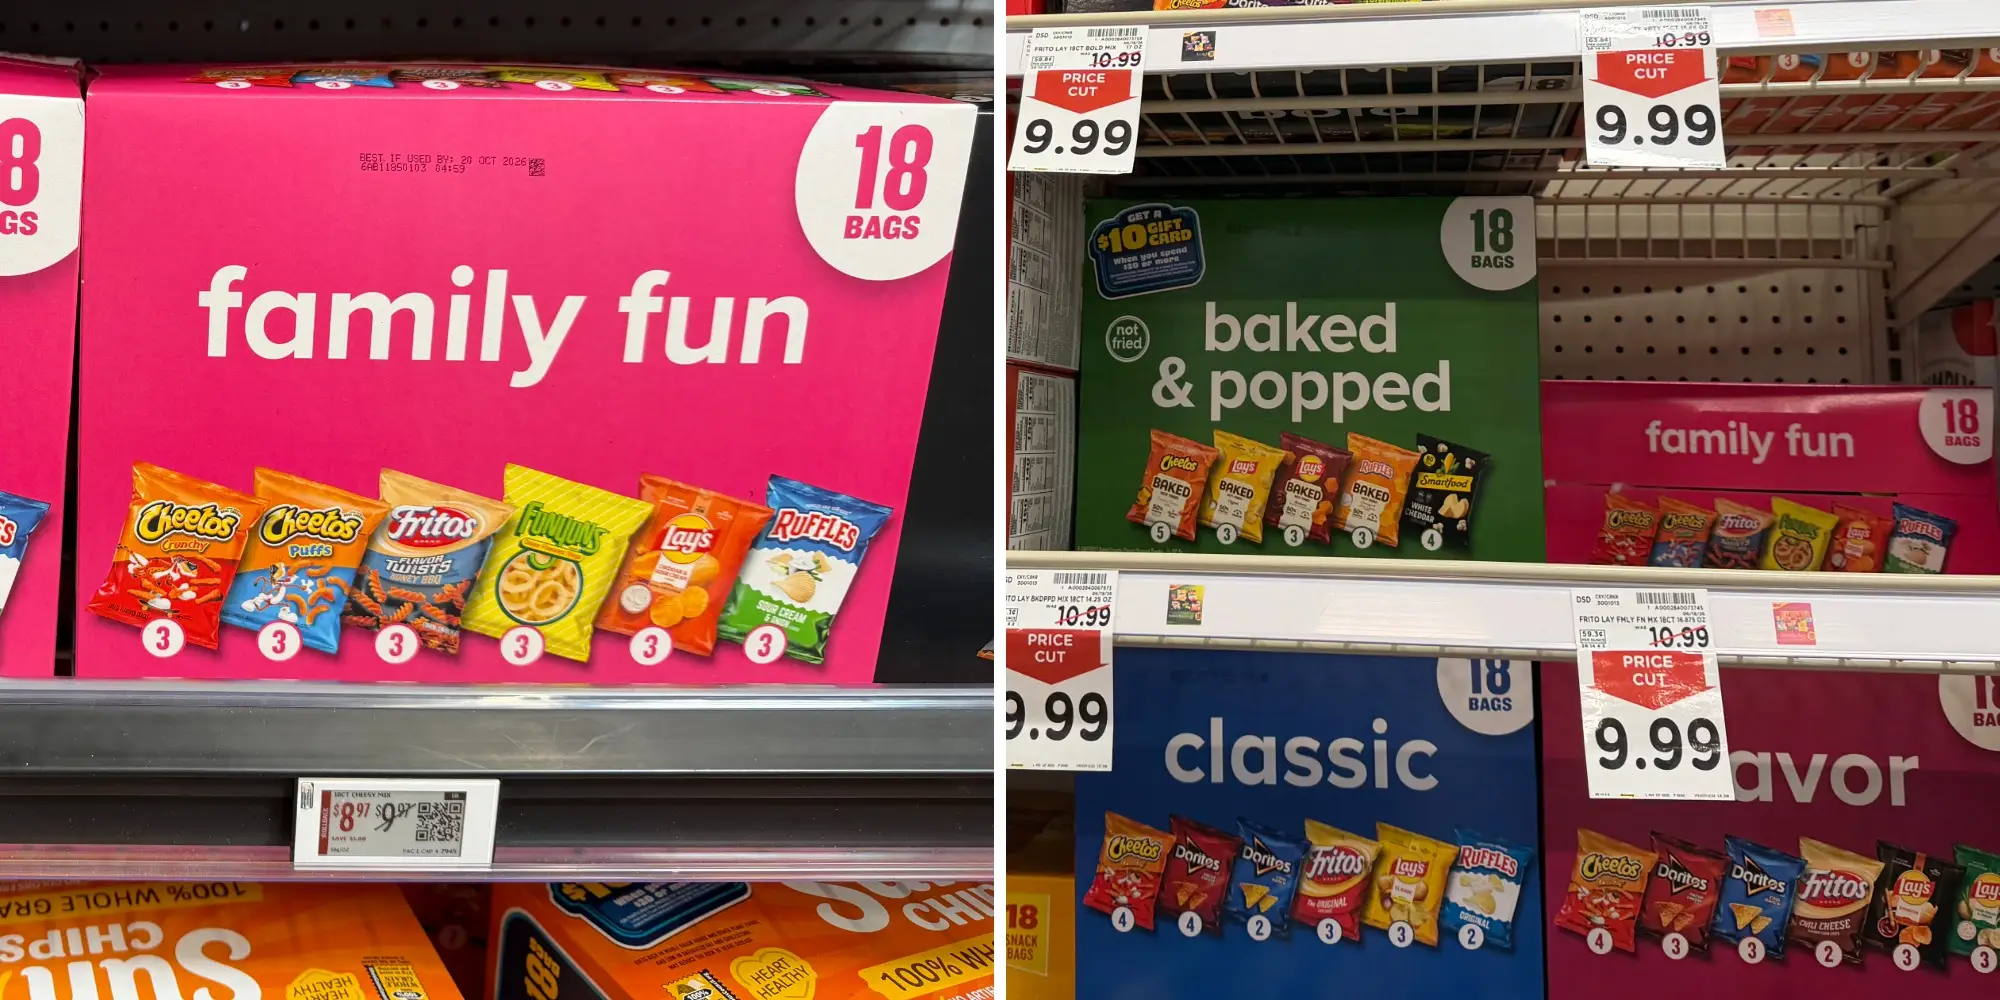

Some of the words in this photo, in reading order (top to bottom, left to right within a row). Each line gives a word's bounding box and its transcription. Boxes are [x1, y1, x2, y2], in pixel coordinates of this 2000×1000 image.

[1656, 32, 1710, 47] 10.99
[1092, 52, 1141, 68] 10.99
[1626, 53, 1675, 64] PRICE
[1063, 73, 1105, 83] PRICE
[1634, 68, 1667, 79] CUT
[1068, 86, 1098, 97] CUT
[1596, 104, 1716, 145] 9.99
[1023, 119, 1132, 156] 9.99
[360, 153, 384, 163] BEST
[390, 153, 400, 163] IF
[407, 154, 431, 163] USED
[437, 155, 453, 164] BY:
[461, 156, 472, 165] 20
[479, 156, 496, 165] OCT
[503, 157, 527, 166] 2026
[436, 164, 465, 173] 04:59
[855, 124, 933, 211] 18
[1127, 211, 1150, 223] GET
[1147, 218, 1182, 233] GIFT
[844, 215, 920, 239] BAGS
[1470, 208, 1513, 253] 18
[1098, 224, 1147, 253] $10
[1149, 229, 1192, 246] CARD
[1113, 255, 1137, 265] When
[1141, 252, 1157, 261] you
[1161, 247, 1187, 257] spend
[1156, 256, 1179, 265] more
[1471, 256, 1514, 268] BAGS
[199, 264, 587, 388] family
[617, 269, 810, 366] fun
[1116, 323, 1138, 336] not
[1205, 301, 1396, 353] baked
[1112, 336, 1143, 349] fried
[1151, 356, 1196, 408] &
[1210, 359, 1451, 424] popped
[1942, 399, 1979, 434] 18
[1645, 420, 1774, 464] family
[1785, 423, 1855, 457] fun
[1945, 435, 1980, 447] BAGS
[1160, 454, 1198, 472] Cheetos
[1232, 459, 1256, 474] Lay's
[1300, 461, 1323, 475] Lay's
[1359, 460, 1394, 478] RUFFLES
[1153, 477, 1191, 498] BAKED
[1220, 480, 1254, 499] BAKED
[1420, 475, 1469, 488] Smartfood
[1287, 482, 1321, 501] BAKED
[1353, 483, 1390, 502] BAKED
[1405, 509, 1434, 523] CHEDDAR
[1412, 501, 1432, 514] WHITE
[136, 501, 238, 542] Cheetos
[261, 505, 362, 545] Cheetos
[388, 505, 477, 540] Fritos
[1608, 510, 1652, 529] Cheetos
[1662, 513, 1706, 531] Cheetos
[1720, 513, 1760, 529] Fritos
[1900, 518, 1943, 539] RUFFLES
[768, 508, 860, 551] RUFFLES
[1157, 526, 1163, 539] 5
[1224, 528, 1231, 541] 3
[1290, 530, 1297, 543] 3
[1358, 532, 1366, 545] 3
[161, 540, 209, 552] Crunchy
[660, 525, 713, 554] Lay's
[1428, 534, 1434, 546] 4
[289, 545, 333, 557] Puffs
[399, 555, 444, 565] FLAVOR
[385, 559, 452, 574] TWISTS
[390, 573, 420, 583] HONEY
[421, 574, 442, 585] BBQ
[756, 600, 777, 613] SOUR
[779, 606, 807, 624] CREAM
[1058, 605, 1110, 626] 10.99
[156, 626, 170, 650] 3
[272, 630, 286, 654] 3
[389, 632, 403, 656] 3
[757, 633, 772, 657] 3
[1028, 634, 1073, 646] PRICE
[1649, 626, 1709, 648] 10.99
[514, 635, 529, 658] 3
[643, 635, 658, 658] 3
[1035, 651, 1066, 663] CUT
[1623, 655, 1673, 668] PRICE
[1470, 659, 1511, 695] 18
[1633, 673, 1666, 686] CUT
[1468, 697, 1512, 712] BAGS
[1006, 691, 1108, 741] 9.99
[1596, 717, 1720, 771] 9.99
[1164, 717, 1439, 791] classic
[1108, 836, 1161, 861] Cheetos
[1175, 845, 1220, 871] Doritos
[1242, 845, 1291, 873] Doritos
[1306, 846, 1364, 878] Fritos
[1395, 857, 1425, 876] Lay's
[1458, 846, 1518, 877] RUFFLES
[1580, 852, 1642, 881] Cheetos
[1657, 864, 1708, 891] Doritos
[1731, 865, 1786, 893] Doritos
[1800, 869, 1868, 900] Fritos
[167, 881, 247, 900] 100%
[1899, 878, 1930, 898] Lay's
[62, 888, 160, 911] WHOLE
[1316, 897, 1347, 908] ORIGINAL
[1005, 904, 1038, 930] 18
[1118, 912, 1126, 927] 4
[1186, 917, 1194, 932] 4
[1460, 911, 1490, 929] ORIGINAL
[1819, 919, 1851, 930] CHEESE
[1255, 920, 1264, 936] 2
[1325, 924, 1333, 940] 3
[1397, 926, 1406, 942] 3
[1467, 928, 1476, 945] 2
[0, 921, 163, 963] CHIPS
[1006, 934, 1038, 948] SNACK
[1595, 933, 1604, 949] 4
[1672, 938, 1680, 954] 3
[1007, 947, 1034, 961] BAGS
[1748, 942, 1757, 959] 3
[1824, 946, 1833, 962] 2
[1902, 949, 1911, 966] 3
[1980, 951, 1989, 968] 3
[750, 957, 792, 984] HEART
[881, 956, 963, 991] 100%
[293, 975, 353, 997] HEALTHY
[757, 964, 811, 1000] HEALTHY
